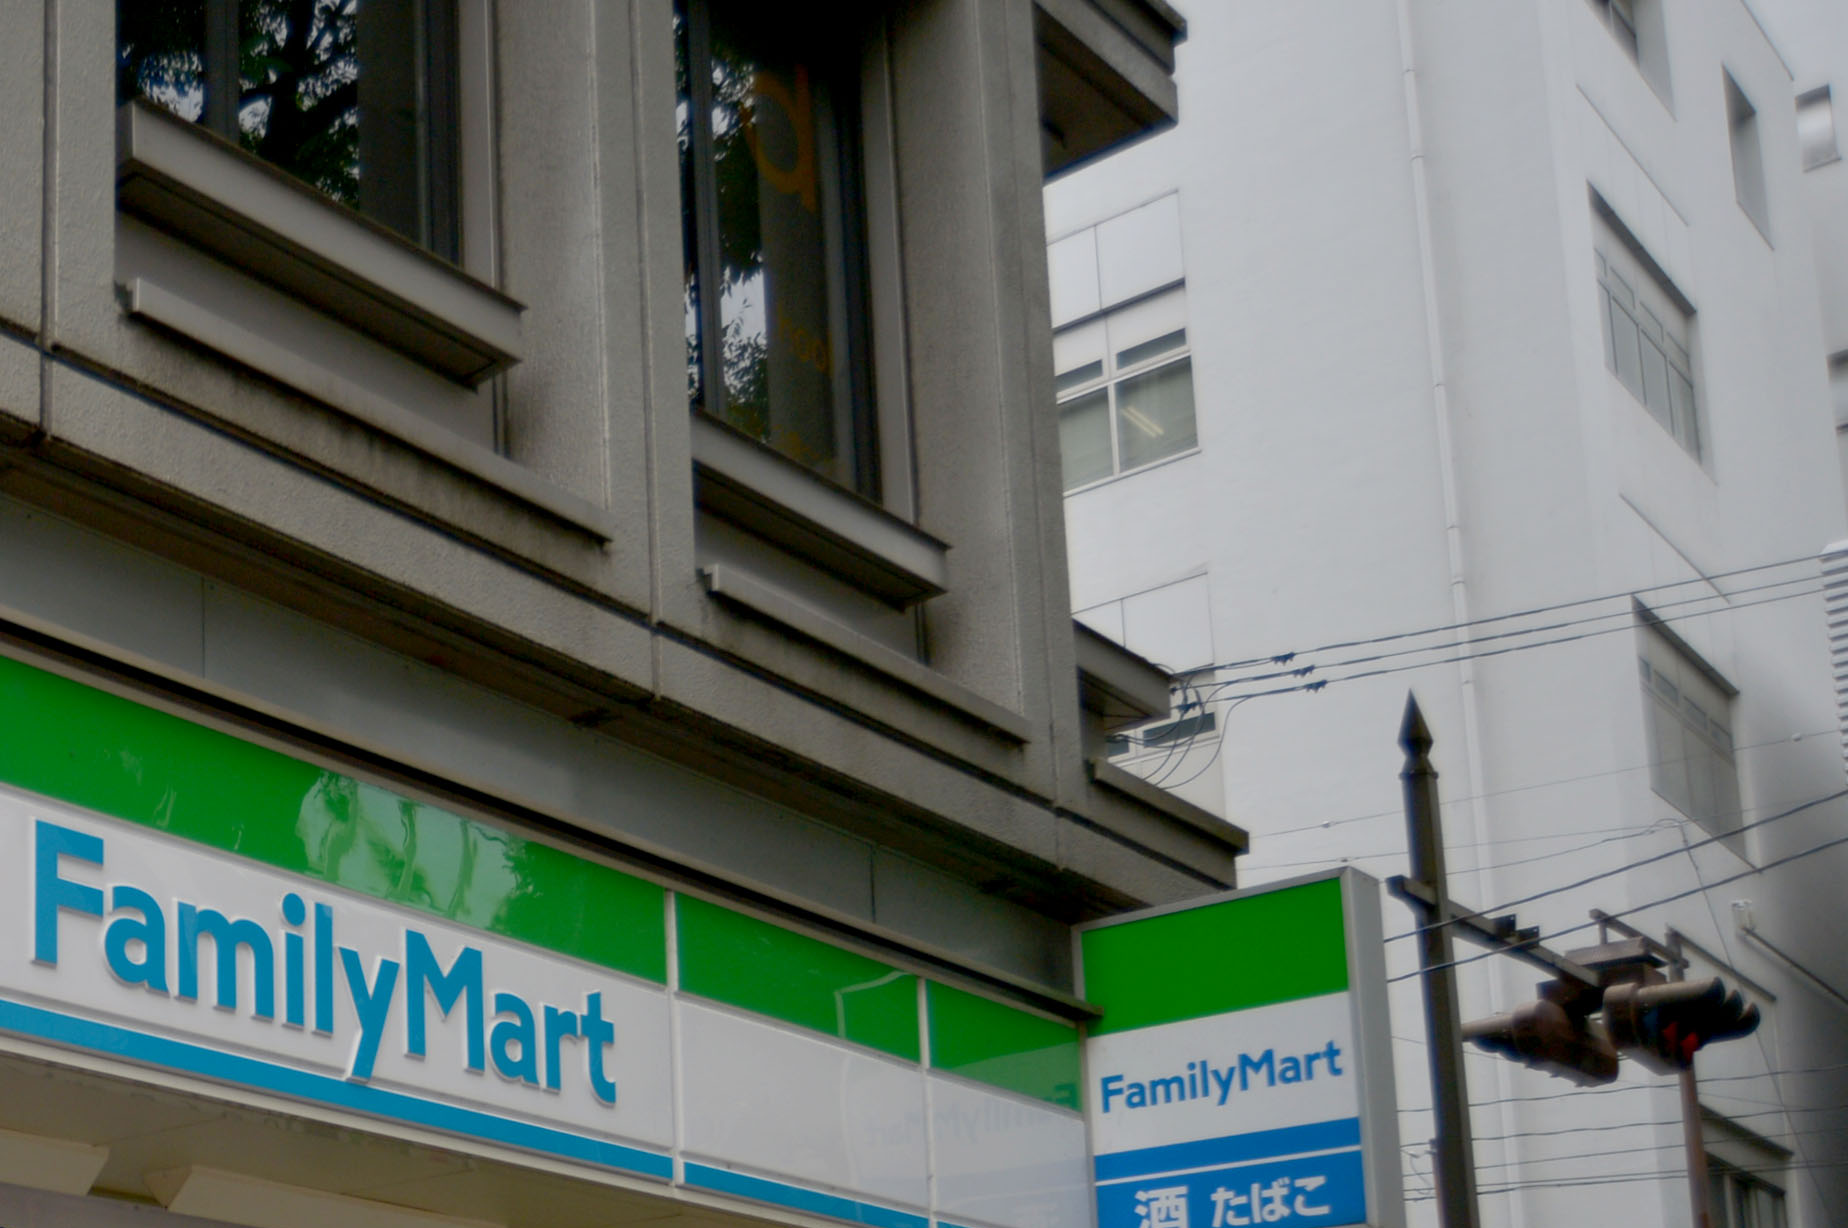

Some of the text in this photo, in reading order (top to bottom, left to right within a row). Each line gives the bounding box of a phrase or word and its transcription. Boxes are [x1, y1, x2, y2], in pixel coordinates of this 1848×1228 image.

[32, 818, 617, 1106] FamilyMart
[1100, 1040, 1343, 1113] FamilyMart
[1210, 1175, 1331, 1228] たばこ
